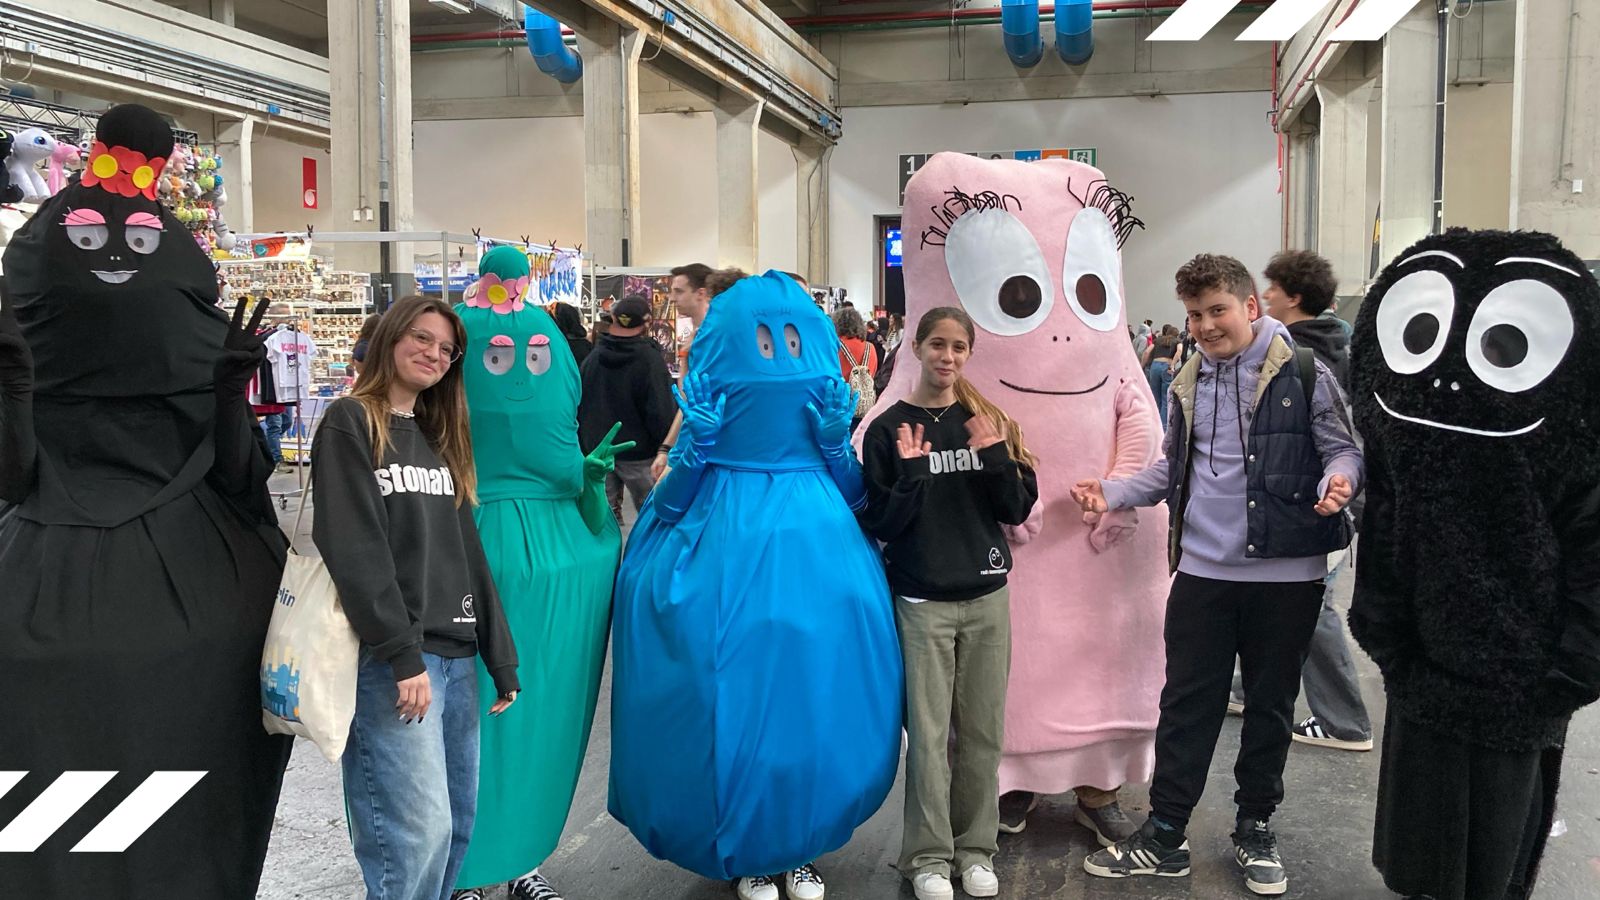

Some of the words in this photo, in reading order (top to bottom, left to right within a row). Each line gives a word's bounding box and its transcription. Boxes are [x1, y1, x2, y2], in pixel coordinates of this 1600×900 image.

[906, 156, 916, 175] 1
[281, 343, 307, 355] KURMI
[929, 446, 984, 474] onat
